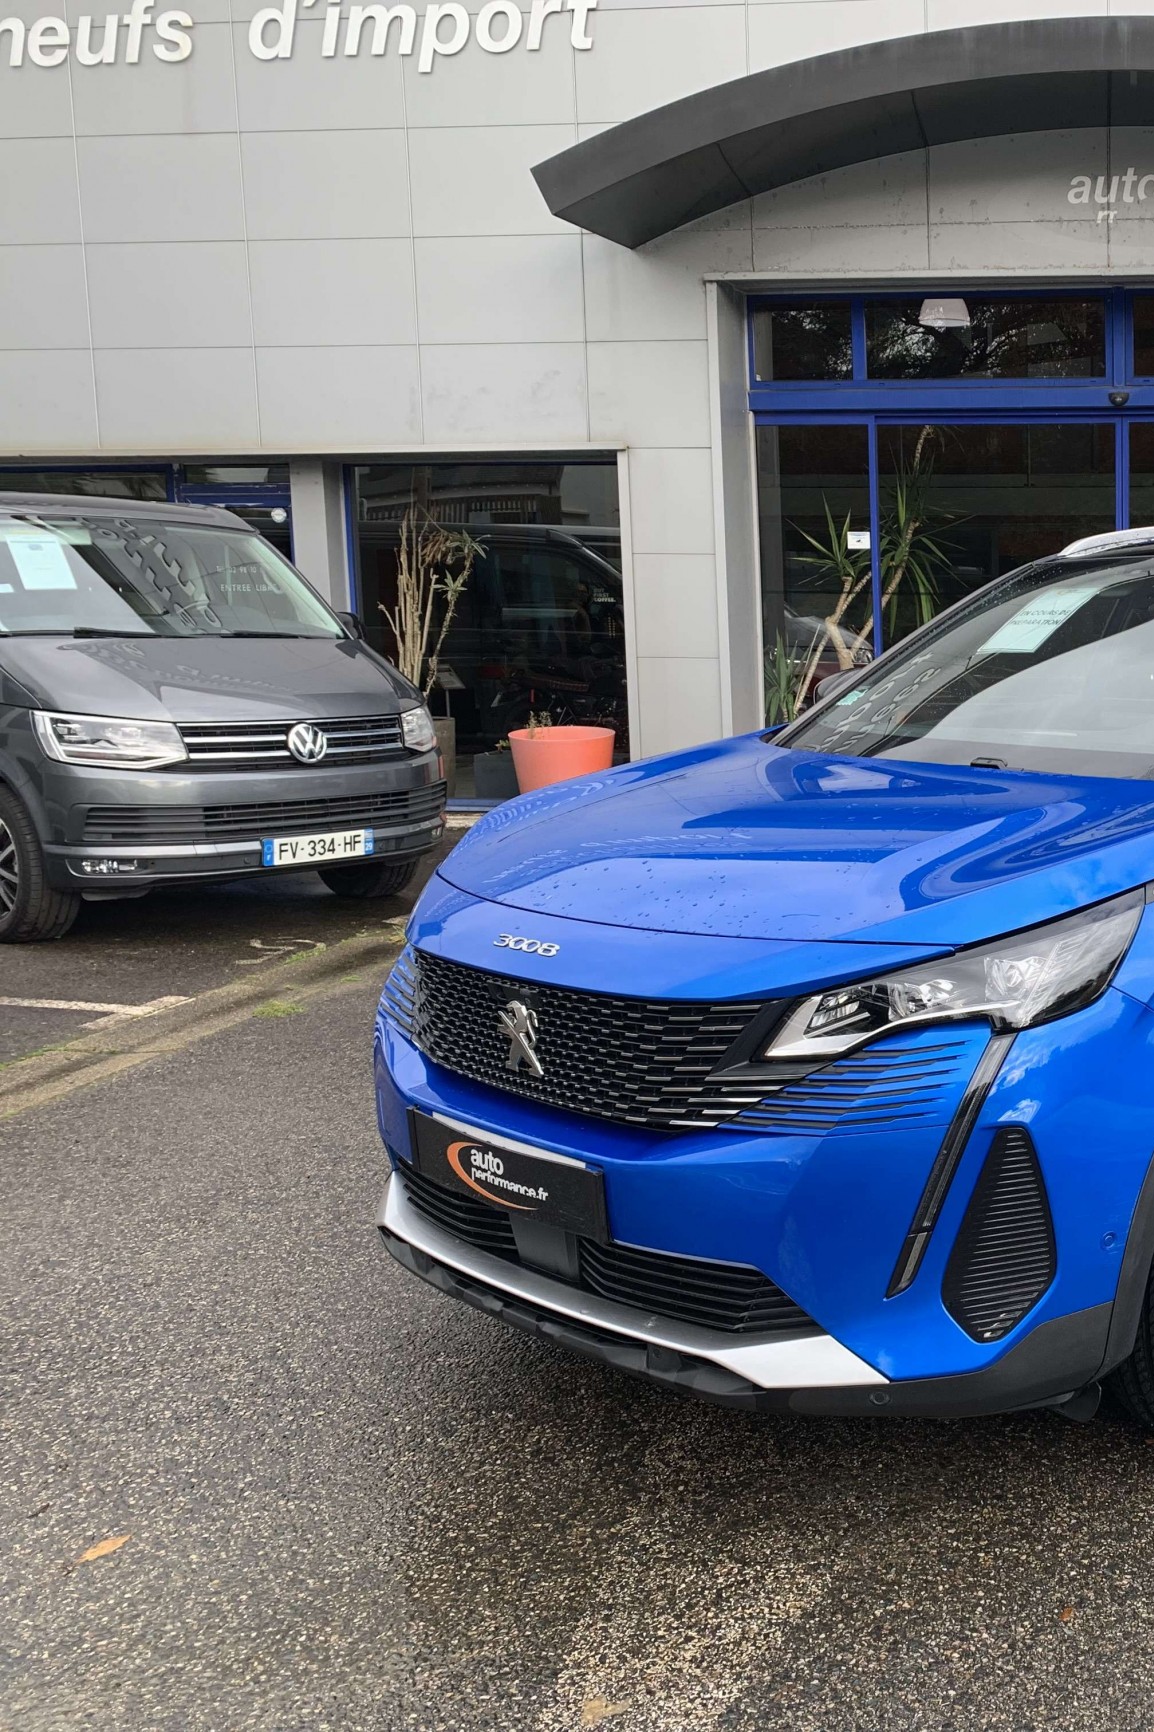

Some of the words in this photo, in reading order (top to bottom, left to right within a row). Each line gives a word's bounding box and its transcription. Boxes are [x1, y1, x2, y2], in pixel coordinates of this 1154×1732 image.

[220, 584, 252, 592] ENTREE
[279, 834, 361, 860] FV-334-HF
[493, 934, 560, 957] 3008
[470, 1148, 504, 1175] auto
[471, 1167, 548, 1201] performance.fr
